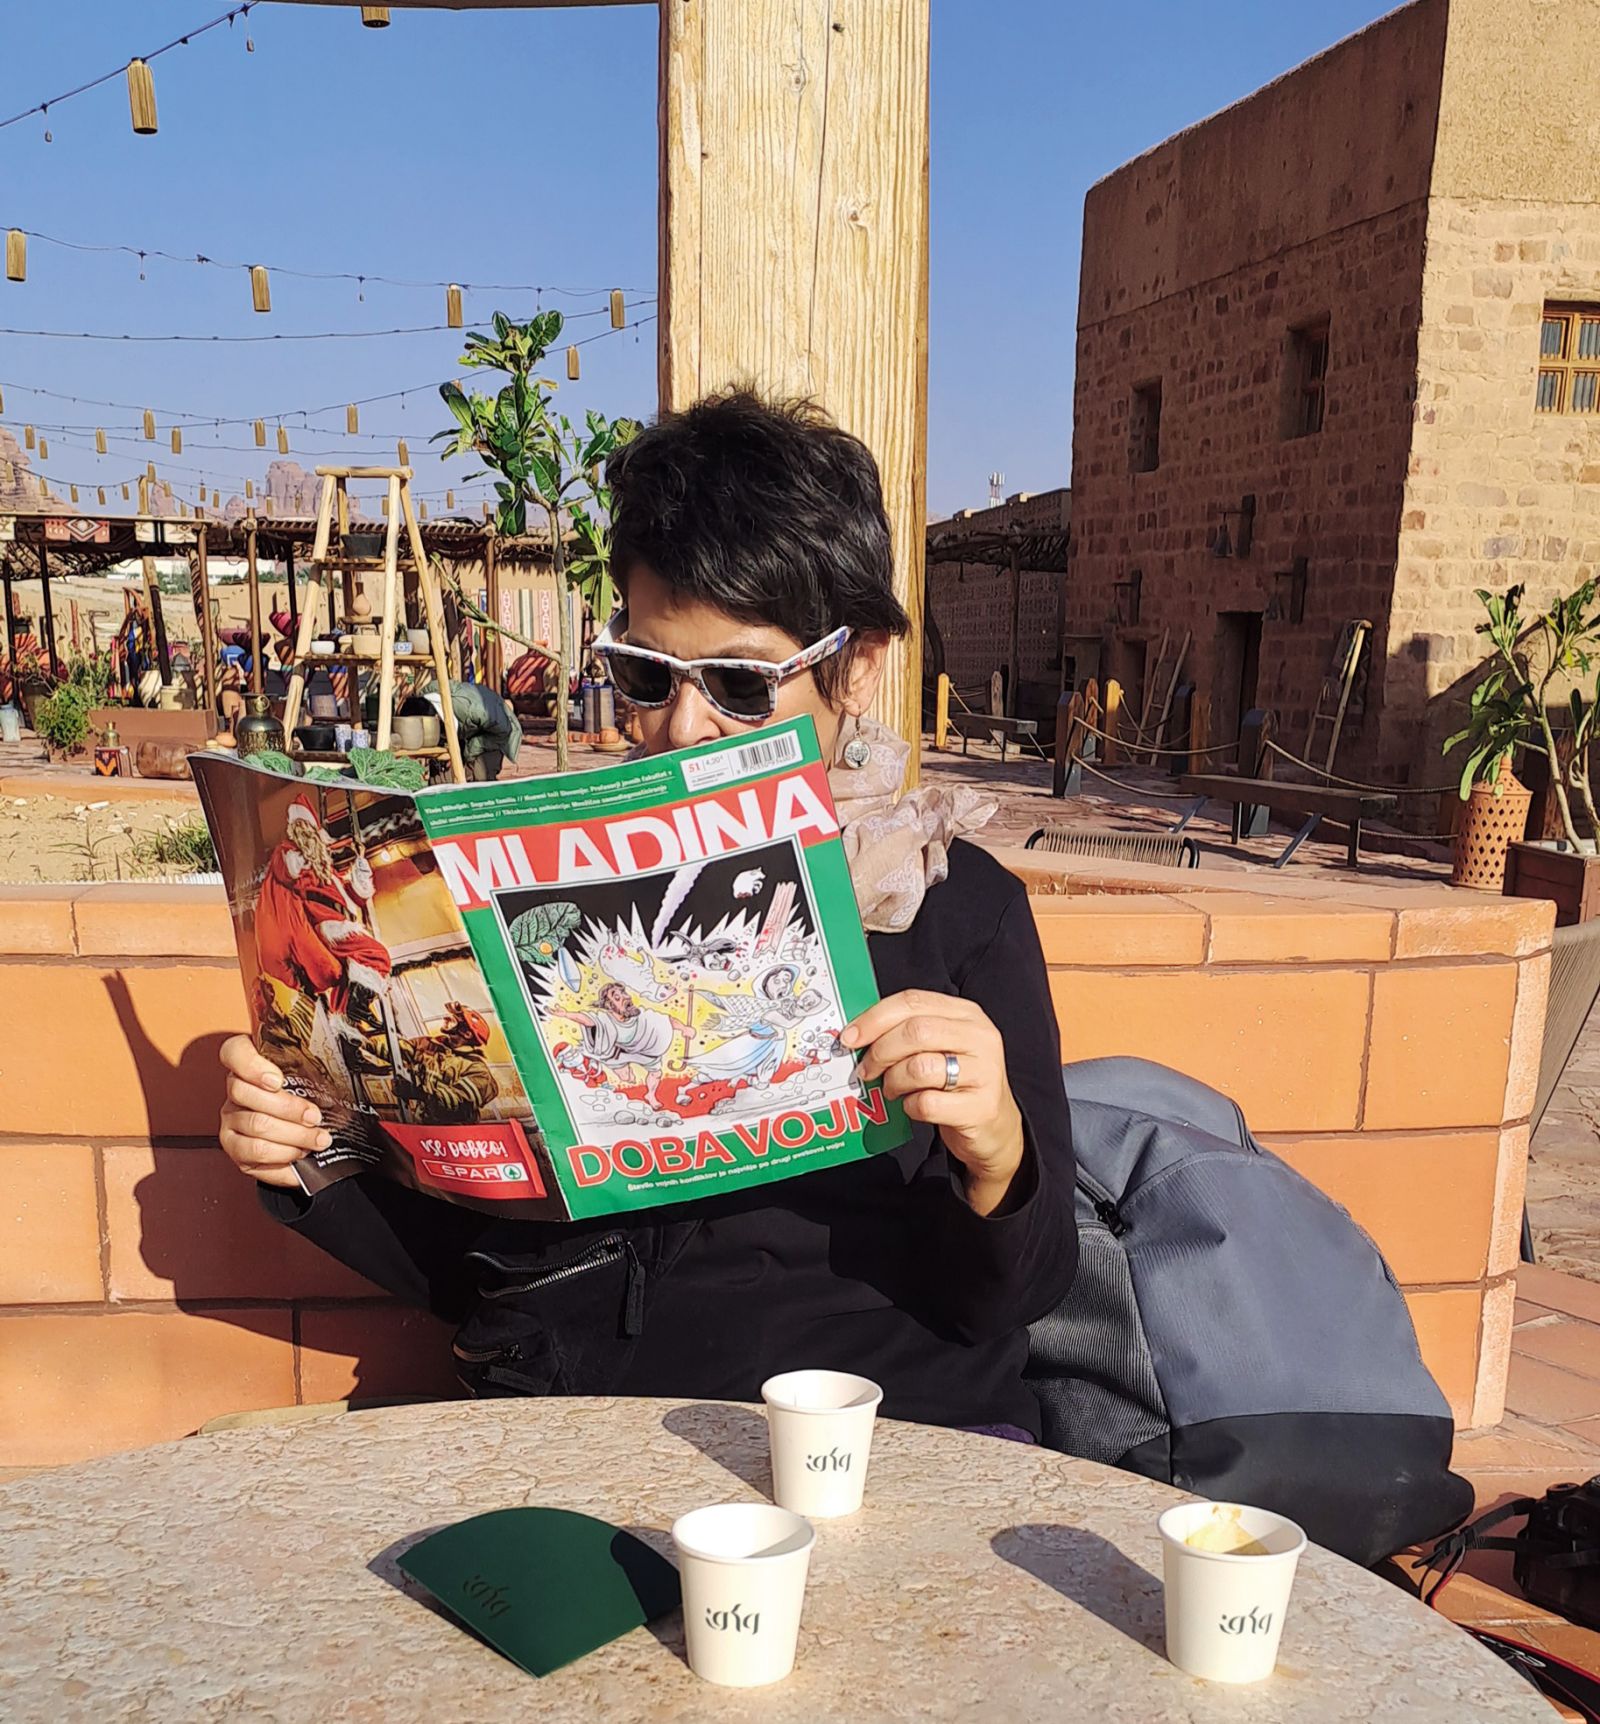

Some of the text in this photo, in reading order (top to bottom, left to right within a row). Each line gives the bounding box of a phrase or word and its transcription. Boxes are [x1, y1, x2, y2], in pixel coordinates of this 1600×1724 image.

[433, 774, 840, 906] MLADINA
[441, 1165, 501, 1180] SPAR
[566, 1087, 889, 1188] DOBA VOJN
